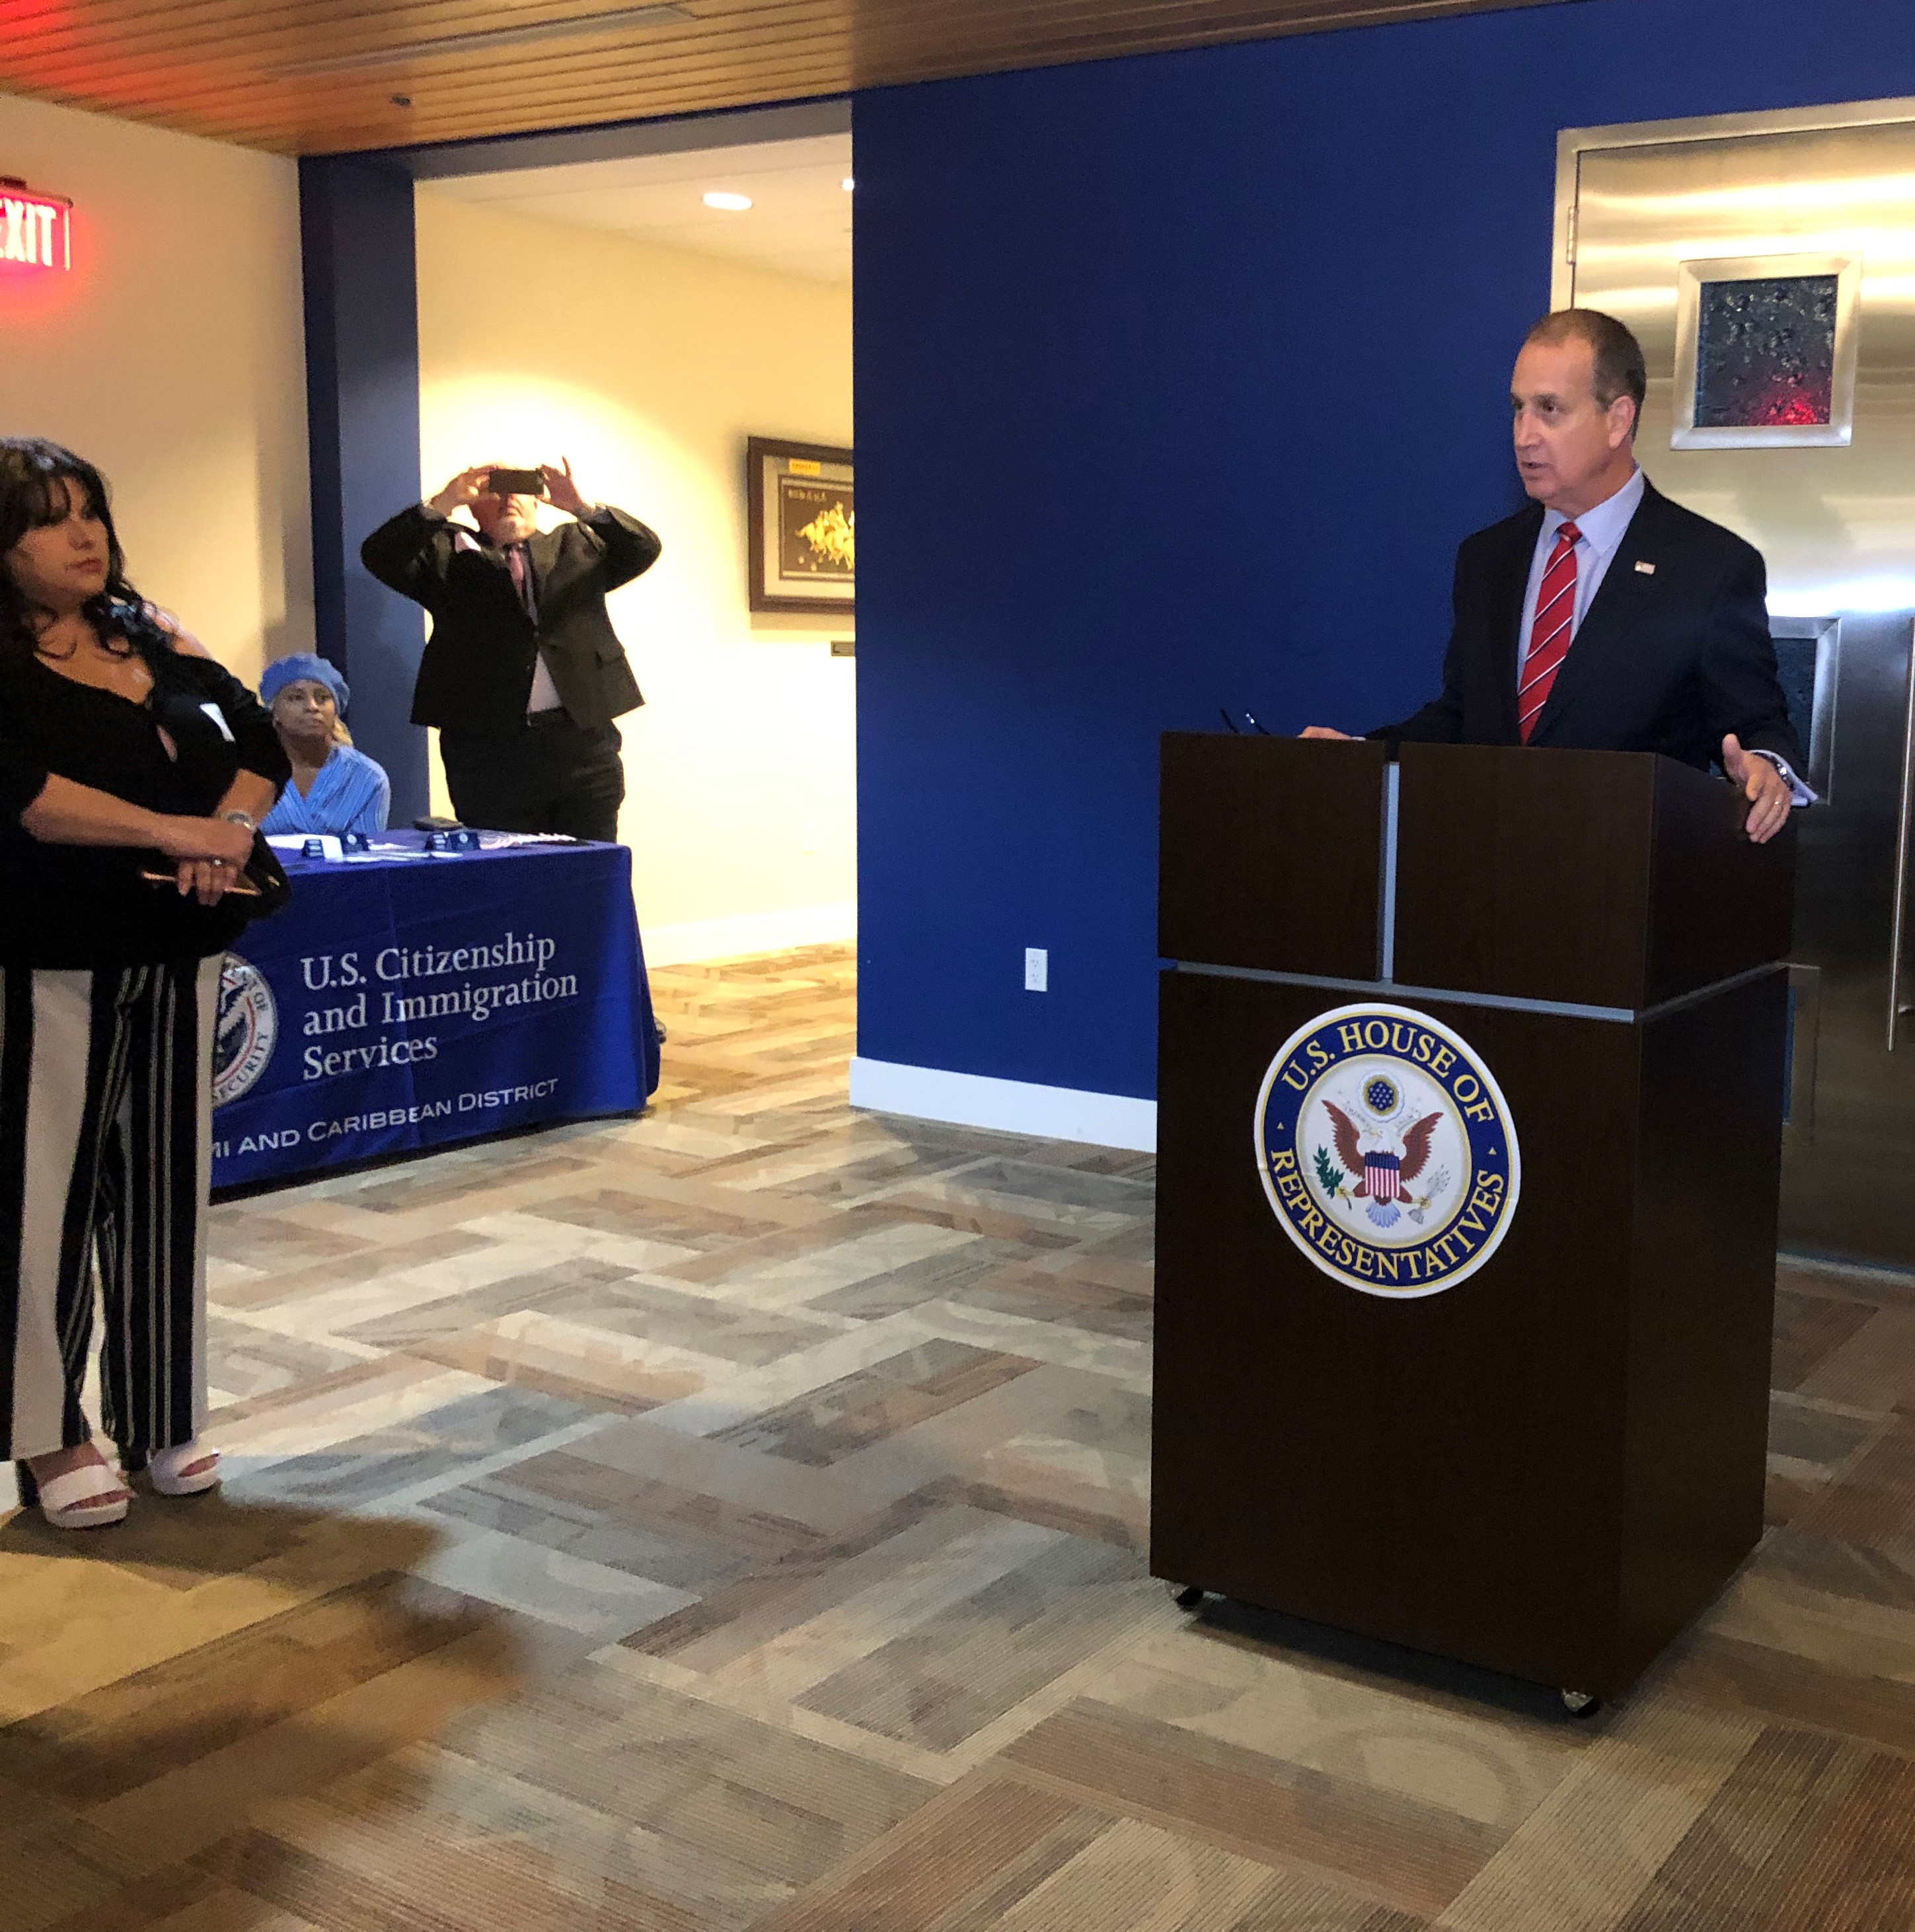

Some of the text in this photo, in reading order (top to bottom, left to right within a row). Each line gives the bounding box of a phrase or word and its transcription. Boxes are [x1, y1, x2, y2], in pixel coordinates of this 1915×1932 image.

[0, 198, 57, 267] XIT
[300, 952, 367, 990] U.S.
[375, 932, 556, 981] Citizenship
[303, 973, 579, 1036] and Immigration
[303, 1036, 439, 1080] Services
[1282, 1020, 1495, 1123] U.S. HOUSE OF
[237, 1129, 301, 1159] AND
[307, 1101, 452, 1142] CARIBBEAN
[459, 1078, 559, 1112] DISTRICT
[1271, 1147, 1505, 1281] REPRESENTATIVES
